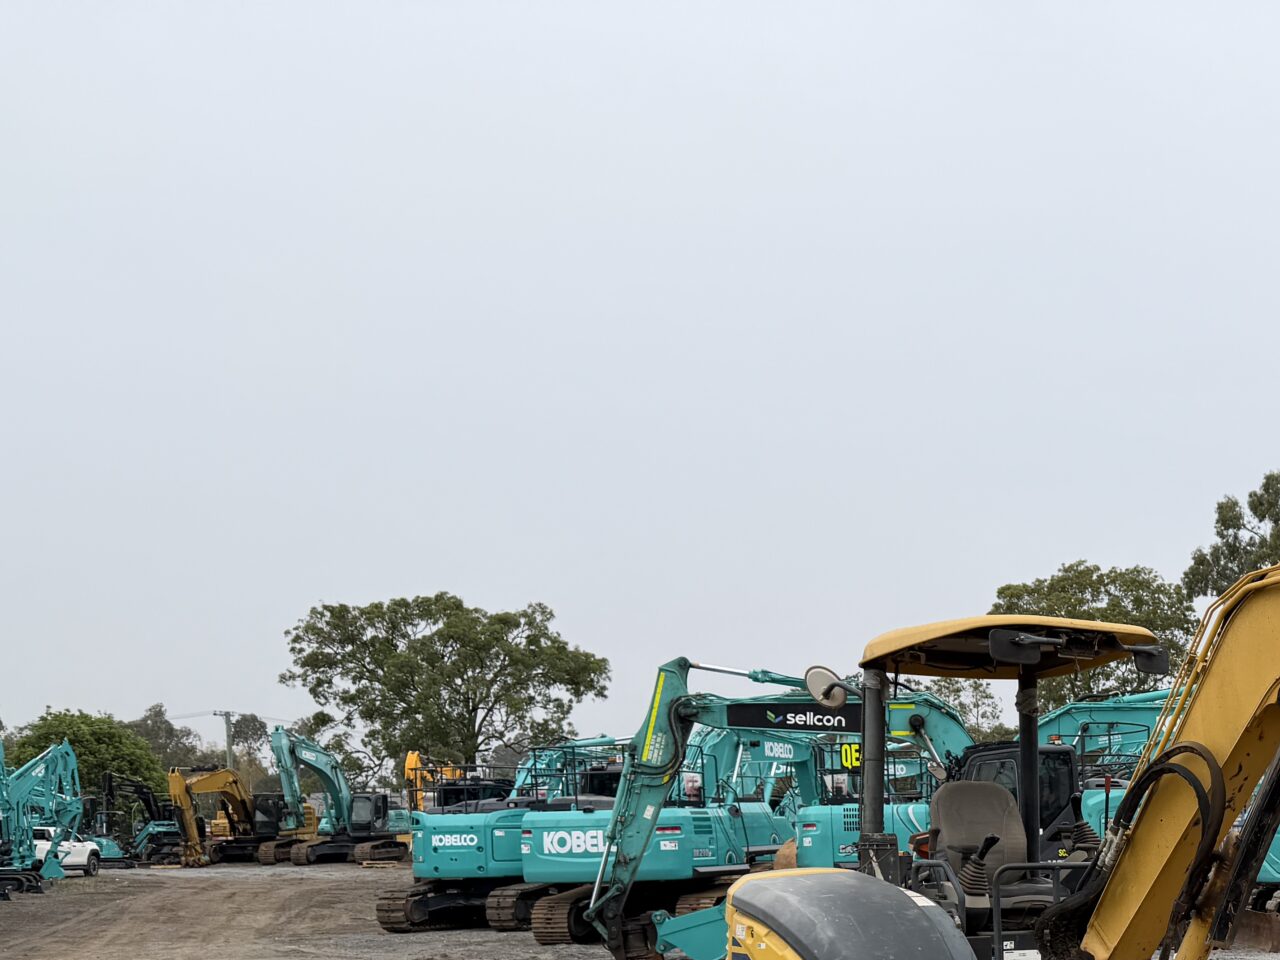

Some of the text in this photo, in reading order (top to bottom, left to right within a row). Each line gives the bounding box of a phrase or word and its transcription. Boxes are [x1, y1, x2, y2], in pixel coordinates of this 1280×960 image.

[785, 711, 847, 728] sellcon
[764, 741, 794, 759] KOBELCO
[431, 834, 478, 847] KOBELCO
